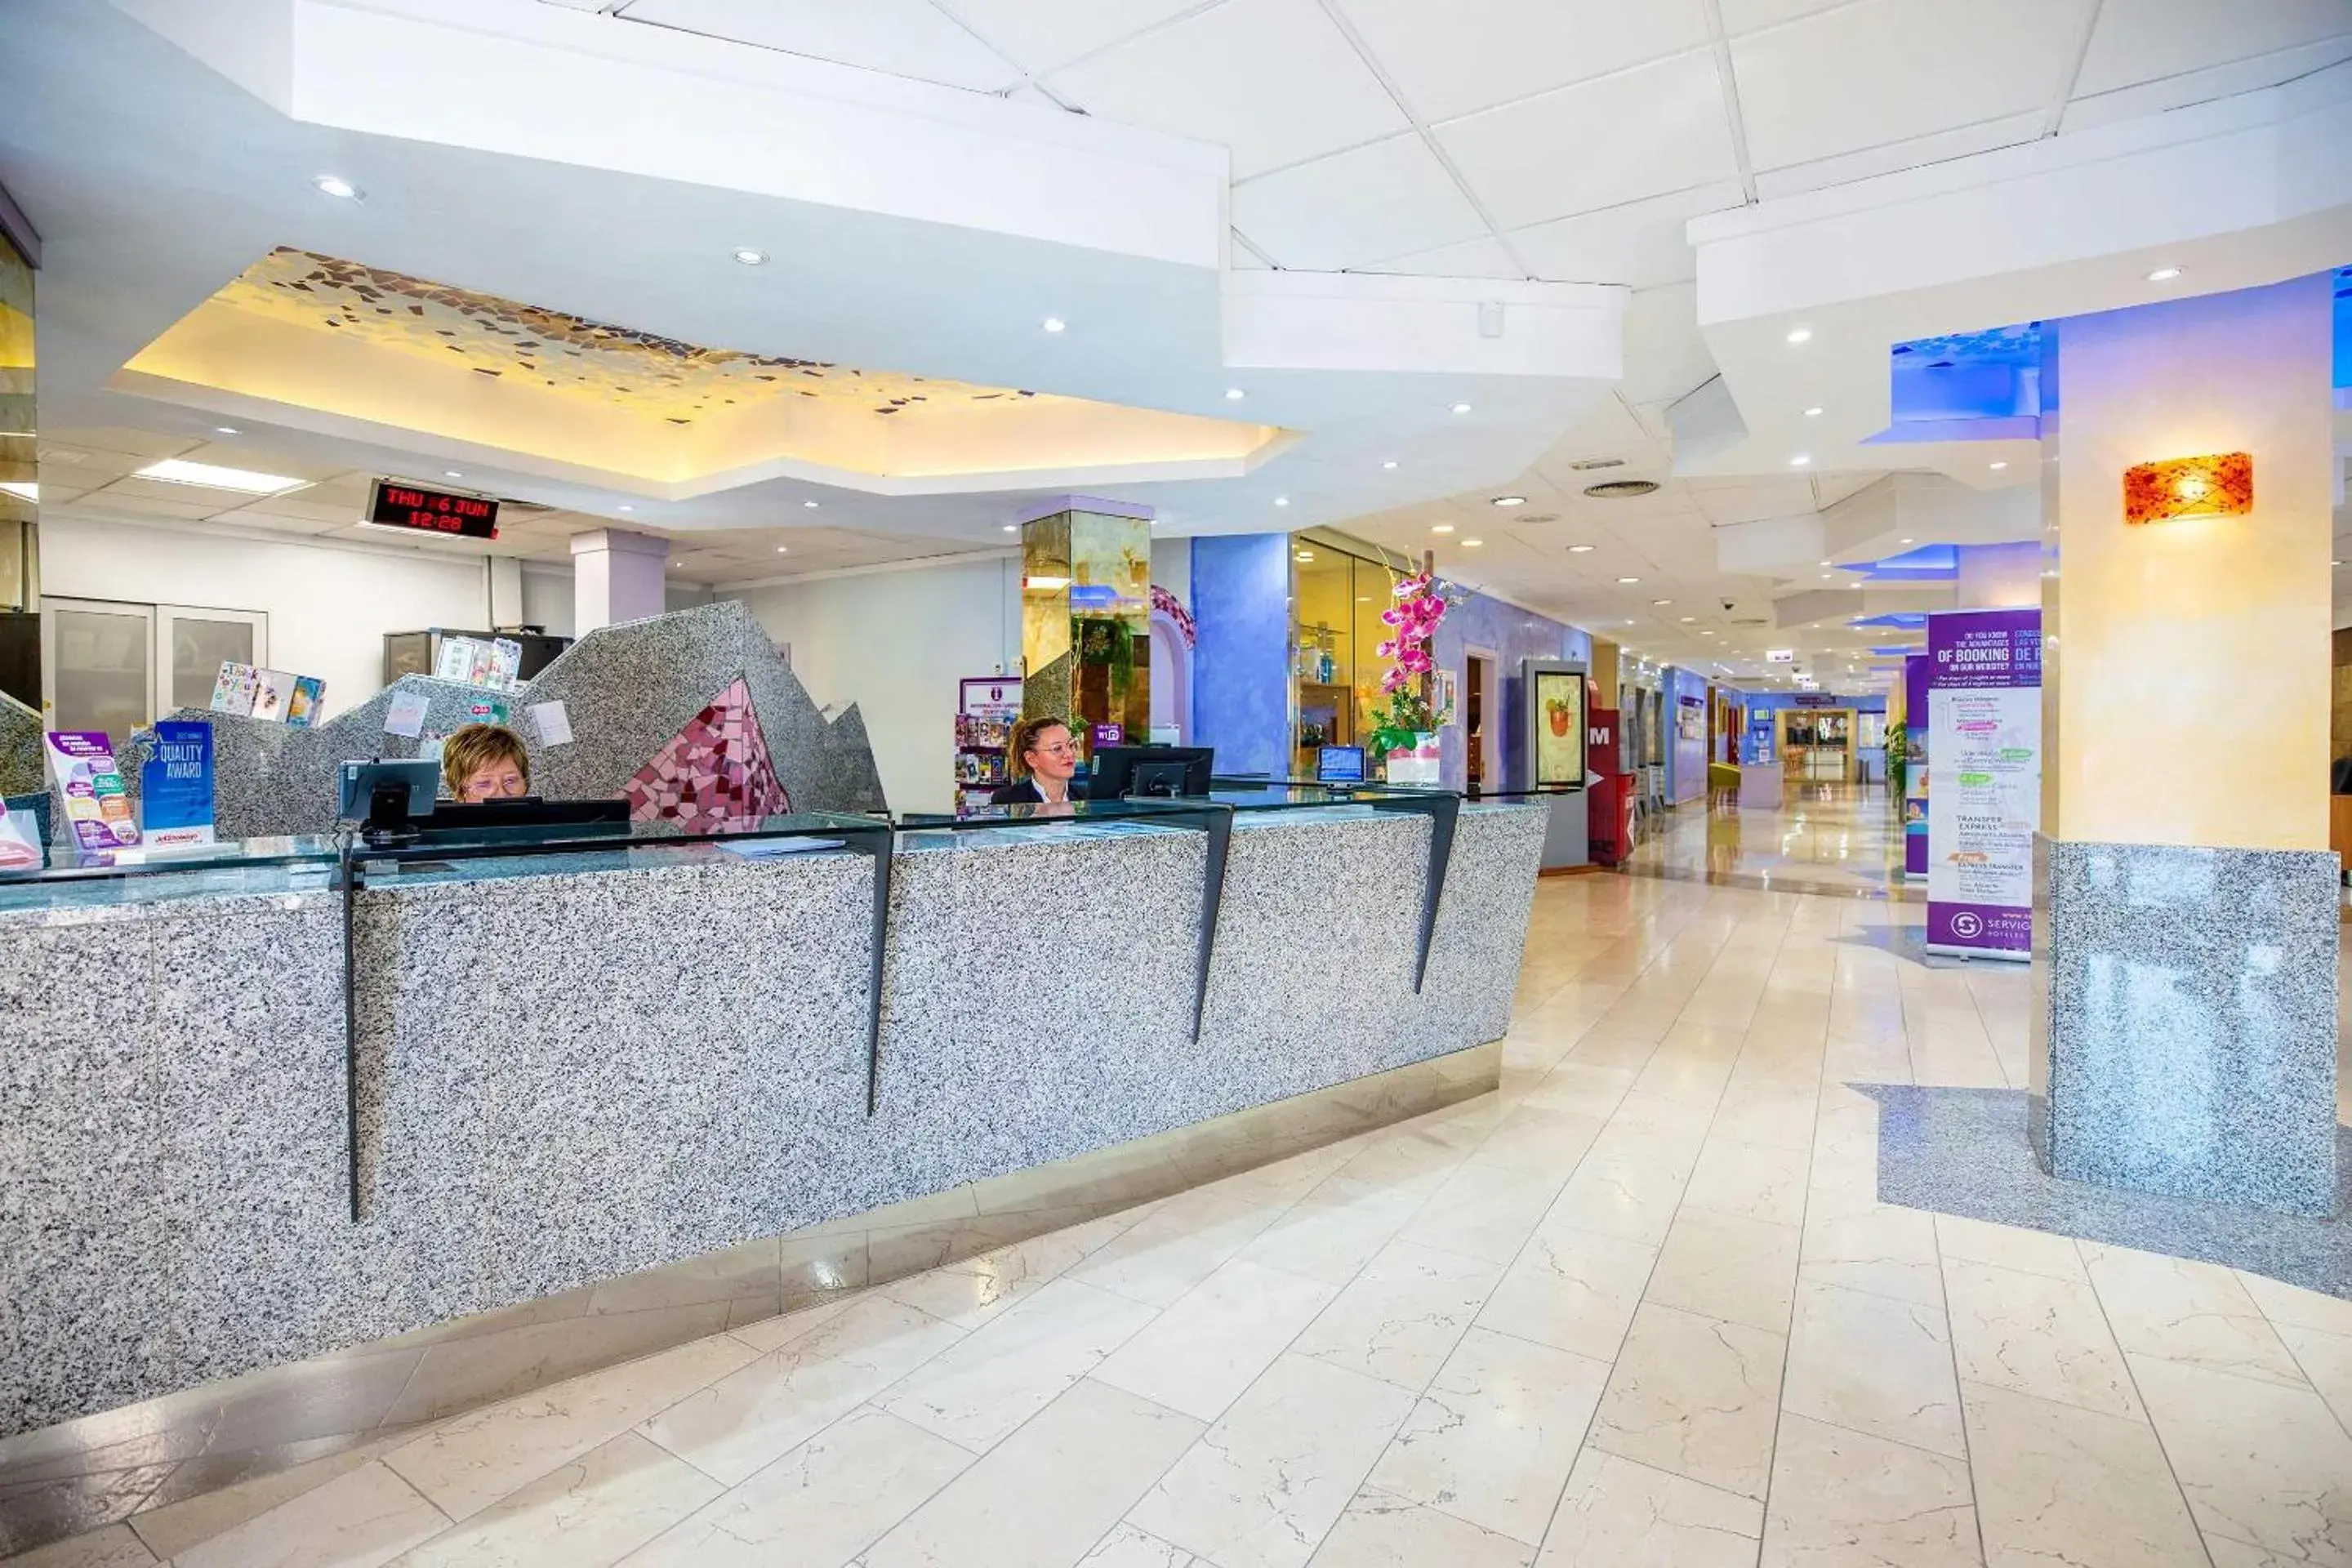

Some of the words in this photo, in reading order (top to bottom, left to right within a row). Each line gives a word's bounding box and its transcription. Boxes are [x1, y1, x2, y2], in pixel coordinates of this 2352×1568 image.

[387, 488, 424, 507] THU
[454, 499, 489, 517] JUN
[410, 511, 462, 531] 12:28
[1938, 650, 1953, 662] OF
[1956, 648, 2009, 662] BOOKING
[2016, 648, 2032, 661] DE
[1975, 662, 2009, 670] WEBSITE?
[1589, 727, 1610, 745] M
[160, 744, 203, 762] QUALITY
[167, 761, 202, 778] AWARD
[1959, 822, 1998, 831] EXPRESS
